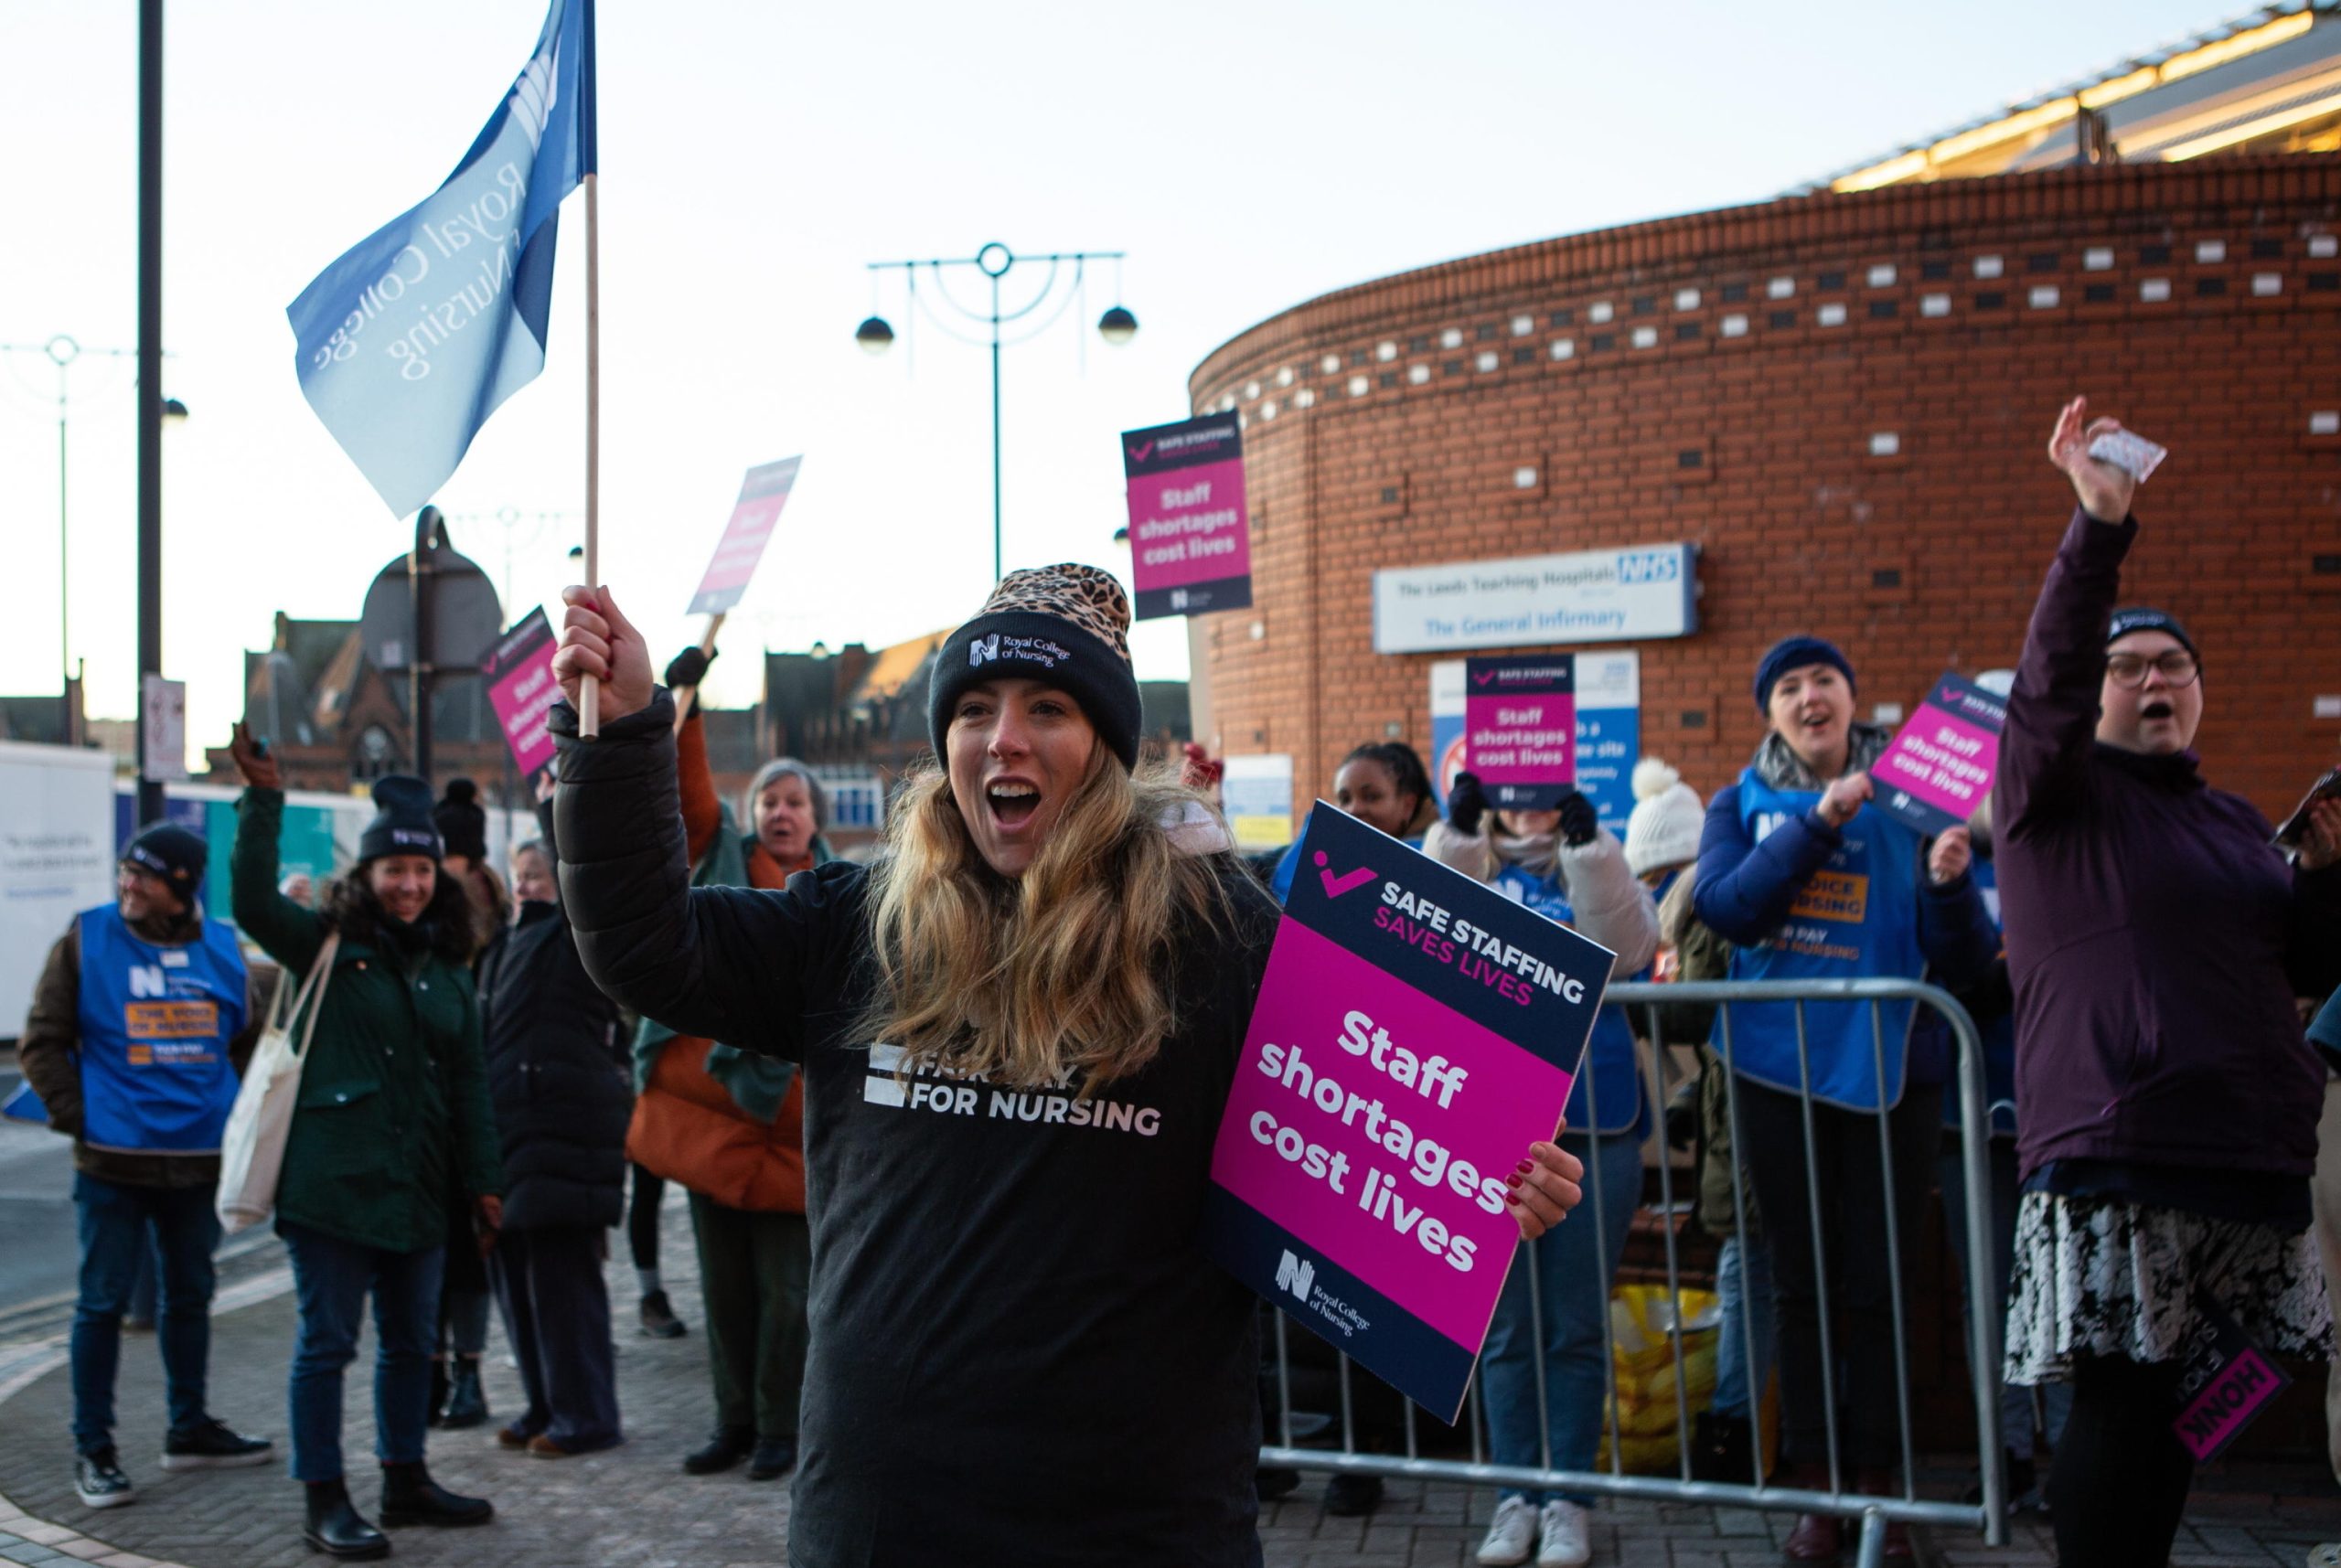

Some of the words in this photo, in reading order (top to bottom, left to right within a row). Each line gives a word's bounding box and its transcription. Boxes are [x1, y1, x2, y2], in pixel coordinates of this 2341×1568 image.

[1160, 482, 1212, 510] Staff
[1138, 509, 1238, 540] shortages
[1144, 541, 1187, 565] cost
[1190, 536, 1235, 560] lives
[1474, 571, 1538, 592] Teaching
[1545, 565, 1616, 586] Hospitals
[1619, 553, 1677, 583] NHS
[1426, 618, 1454, 636] The
[1463, 612, 1532, 635] General
[1539, 608, 1627, 633] Infirmary
[1002, 648, 1014, 658] of
[1015, 649, 1054, 667] Nursing
[1004, 636, 1032, 649] Royal
[1033, 639, 1071, 660] College
[1498, 707, 1543, 726] Staff
[1473, 730, 1566, 748] shortages
[1476, 751, 1516, 766] cost
[1520, 749, 1563, 765] lives
[1936, 726, 1983, 758] Staff
[1892, 752, 1933, 781] cost
[1930, 769, 1974, 800] lives
[1902, 735, 1989, 784] shortages
[1805, 878, 1855, 895] OICE
[1374, 906, 1456, 965] SAVES
[1459, 952, 1534, 1007] LIVES
[1381, 881, 1451, 934] SAFE
[1451, 919, 1586, 1005] STAFFING
[1337, 1009, 1469, 1110] Staff
[911, 1083, 978, 1115] FOR
[989, 1091, 1162, 1136] NURSING
[1256, 1043, 1510, 1215] shortages
[1249, 1111, 1351, 1195] cost
[1359, 1167, 1479, 1273] lives
[1309, 1299, 1320, 1311] of
[1320, 1305, 1353, 1337] Nursing
[1314, 1285, 1339, 1308] Royal
[1338, 1302, 1371, 1330] College
[2182, 1359, 2268, 1446] HONK
